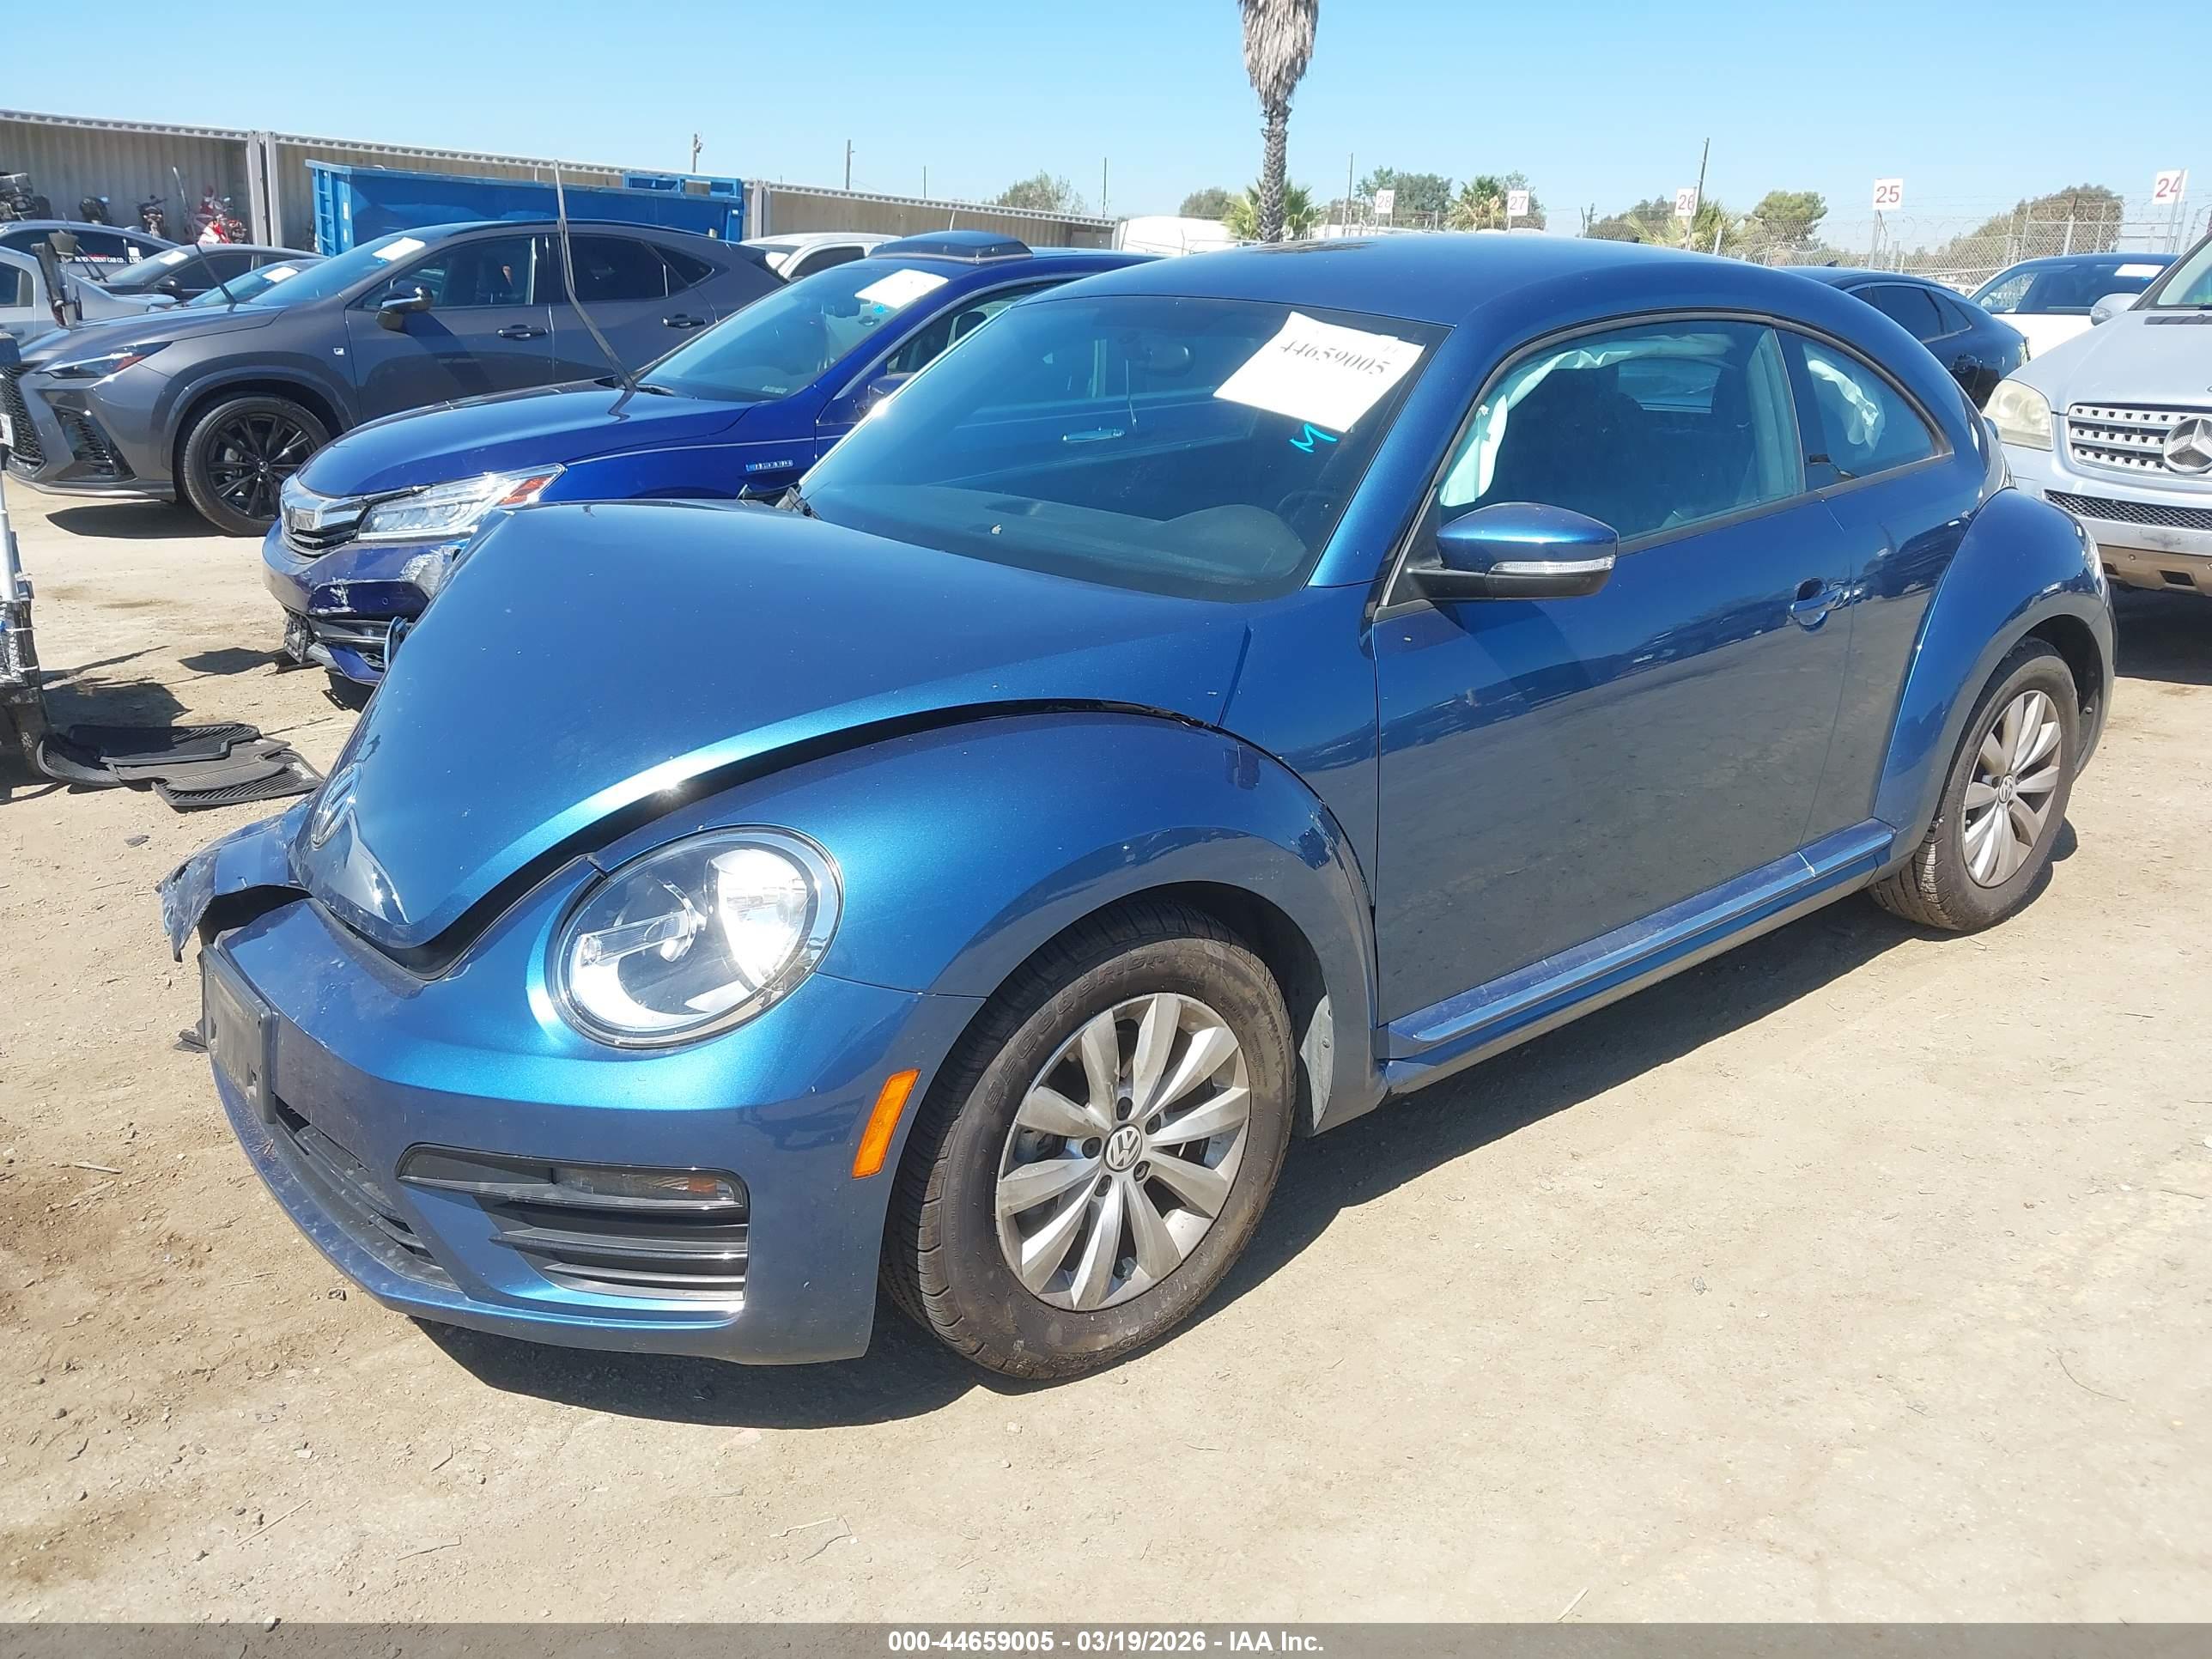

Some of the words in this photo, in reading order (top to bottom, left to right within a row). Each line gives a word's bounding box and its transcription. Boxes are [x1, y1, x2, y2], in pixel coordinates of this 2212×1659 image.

[1875, 185, 1900, 204] 25
[2155, 176, 2182, 198] 24
[1510, 196, 1527, 210] 27
[1678, 194, 1694, 211] 26
[1280, 340, 1391, 374] 44659005
